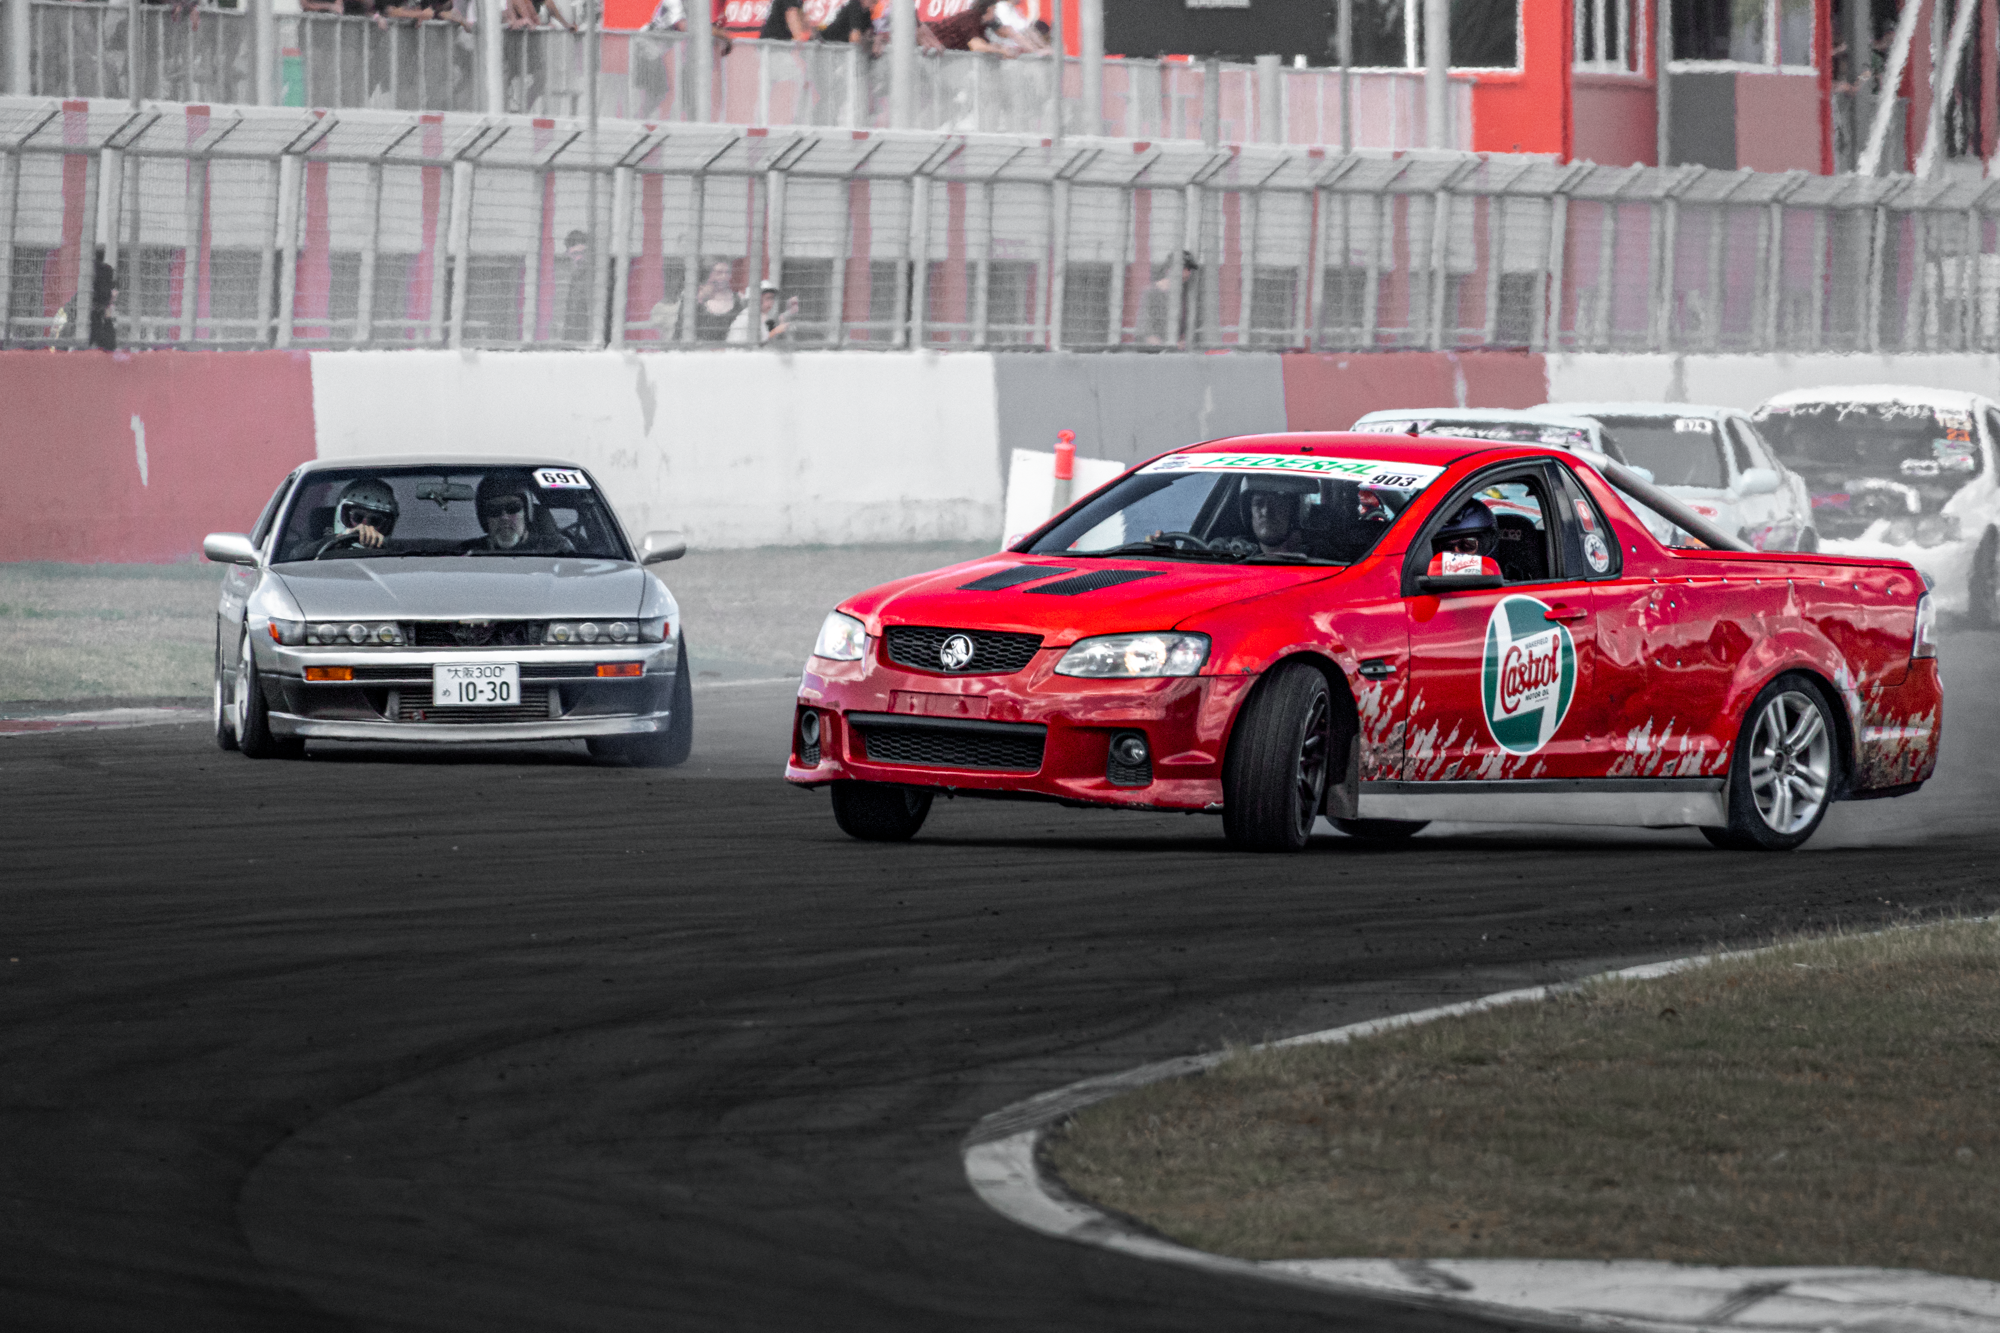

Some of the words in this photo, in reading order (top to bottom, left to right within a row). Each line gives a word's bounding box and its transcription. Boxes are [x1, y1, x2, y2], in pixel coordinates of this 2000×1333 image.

[1202, 456, 1378, 475] FEDERAL
[541, 472, 580, 484] 691
[1369, 474, 1417, 487] 903
[1500, 634, 1559, 714] Castrol
[442, 688, 451, 697] め
[459, 681, 510, 702] 10-30
[1525, 691, 1541, 701] MOTOR
